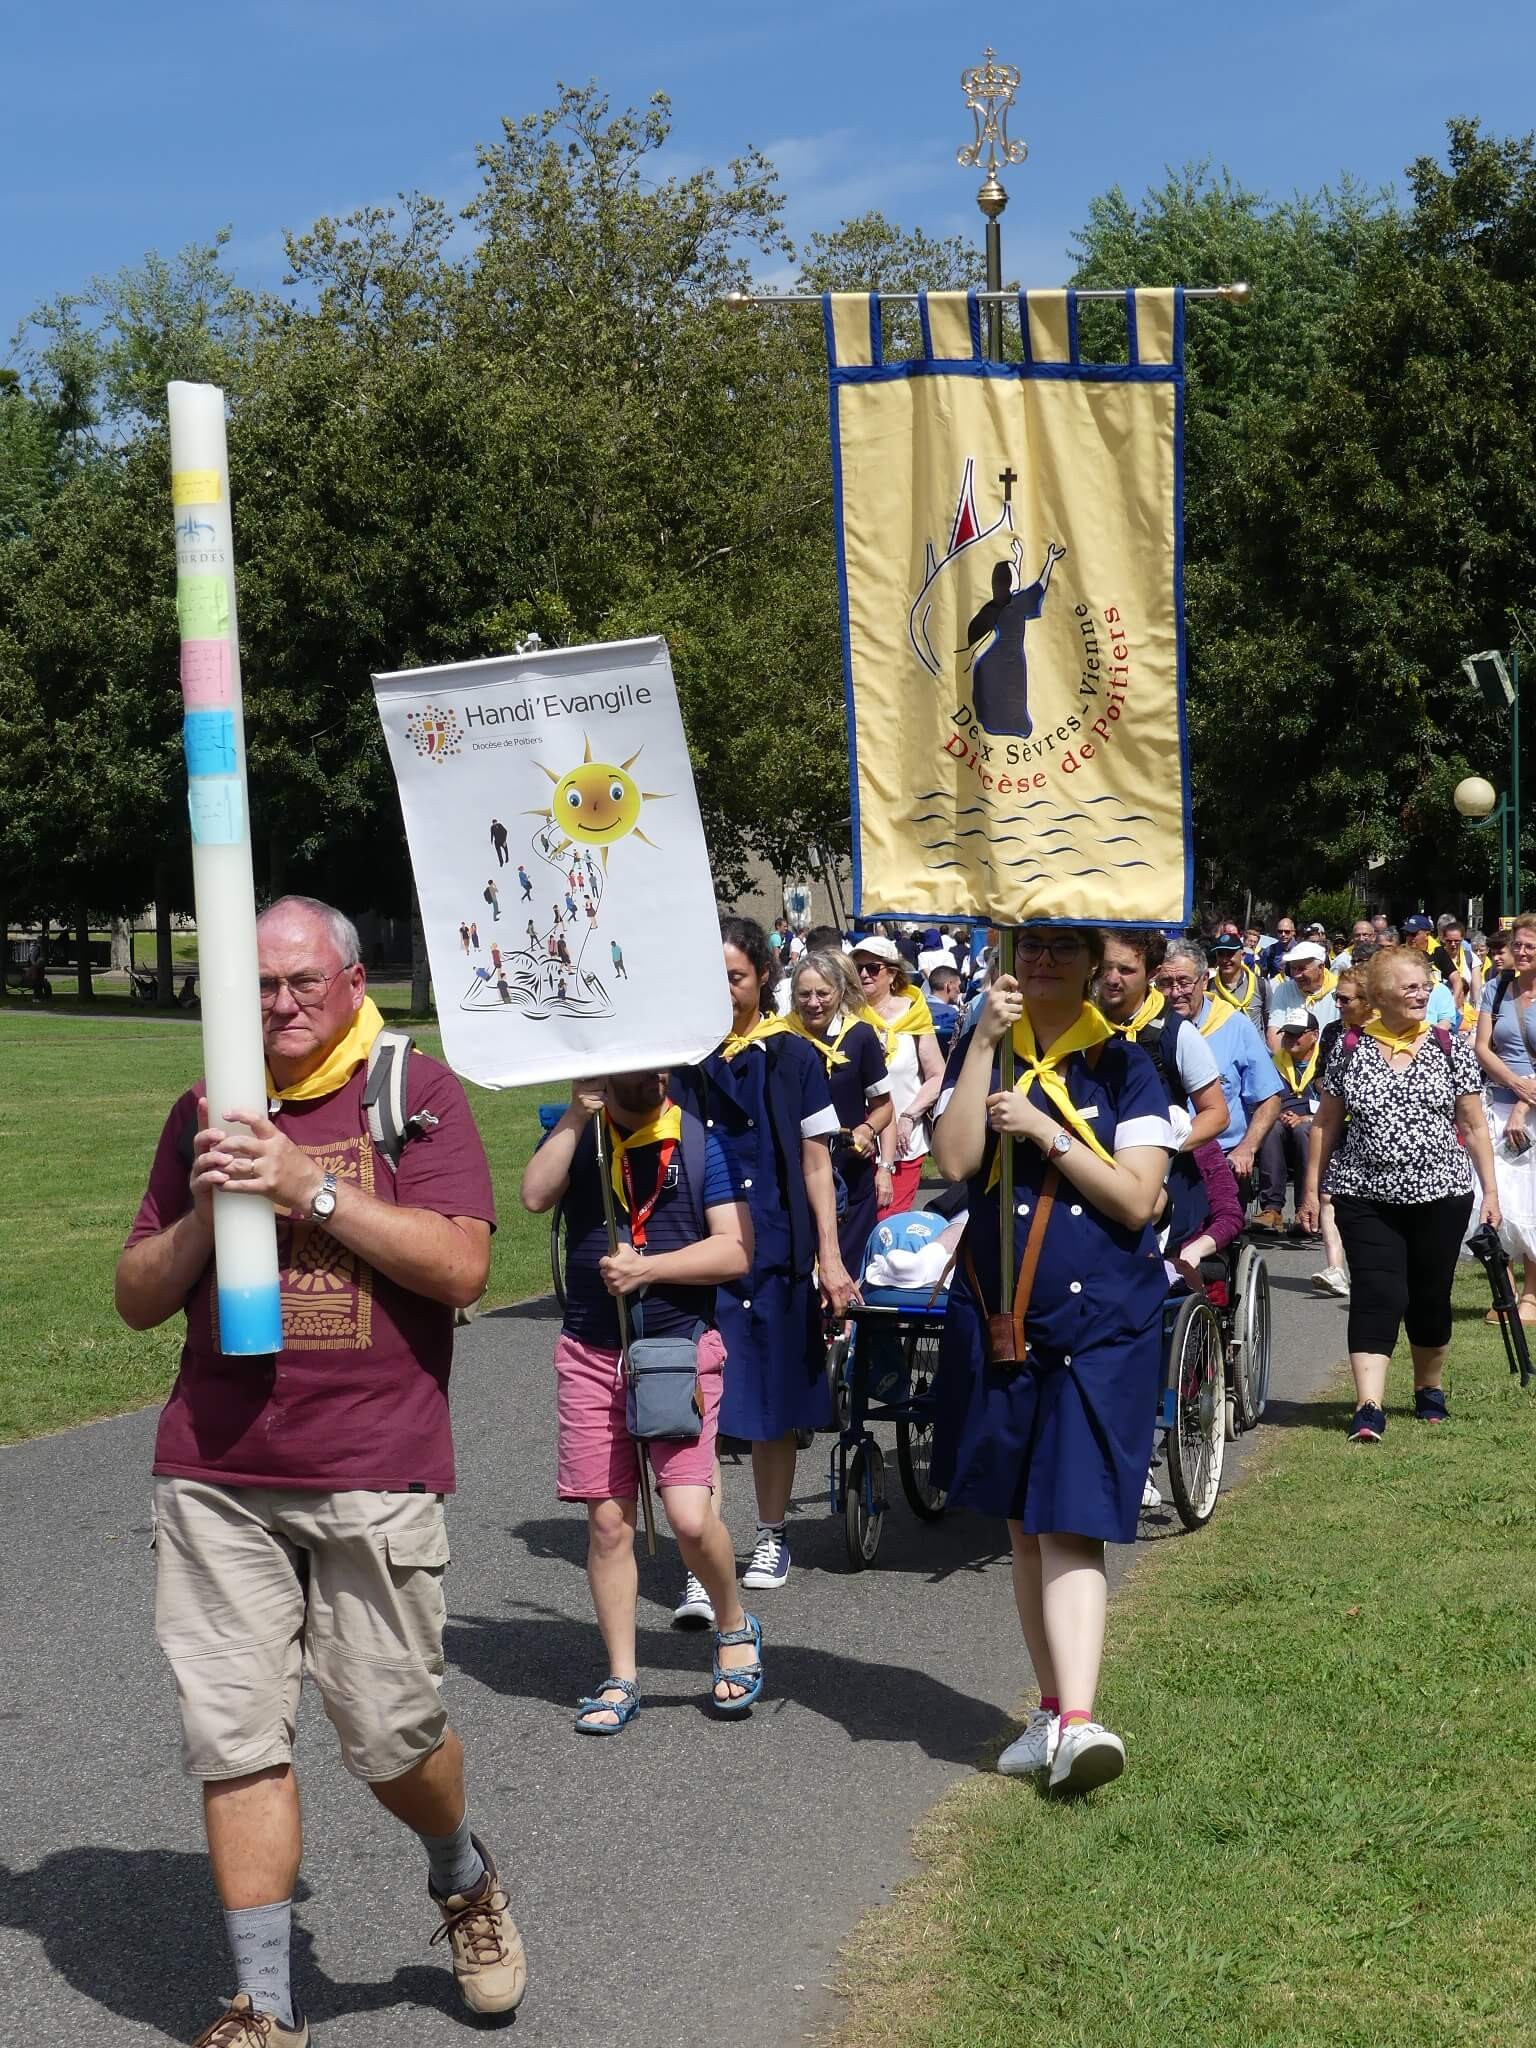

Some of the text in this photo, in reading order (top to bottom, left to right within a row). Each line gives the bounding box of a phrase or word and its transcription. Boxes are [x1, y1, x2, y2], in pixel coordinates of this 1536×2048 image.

[503, 739, 513, 747] de
[513, 737, 543, 746] Poitiers
[951, 704, 994, 762] Dex
[1006, 715, 1081, 765] Sèvres
[1075, 603, 1100, 695] Vienne
[1061, 744, 1095, 774] de
[1091, 607, 1129, 743] Poitiers
